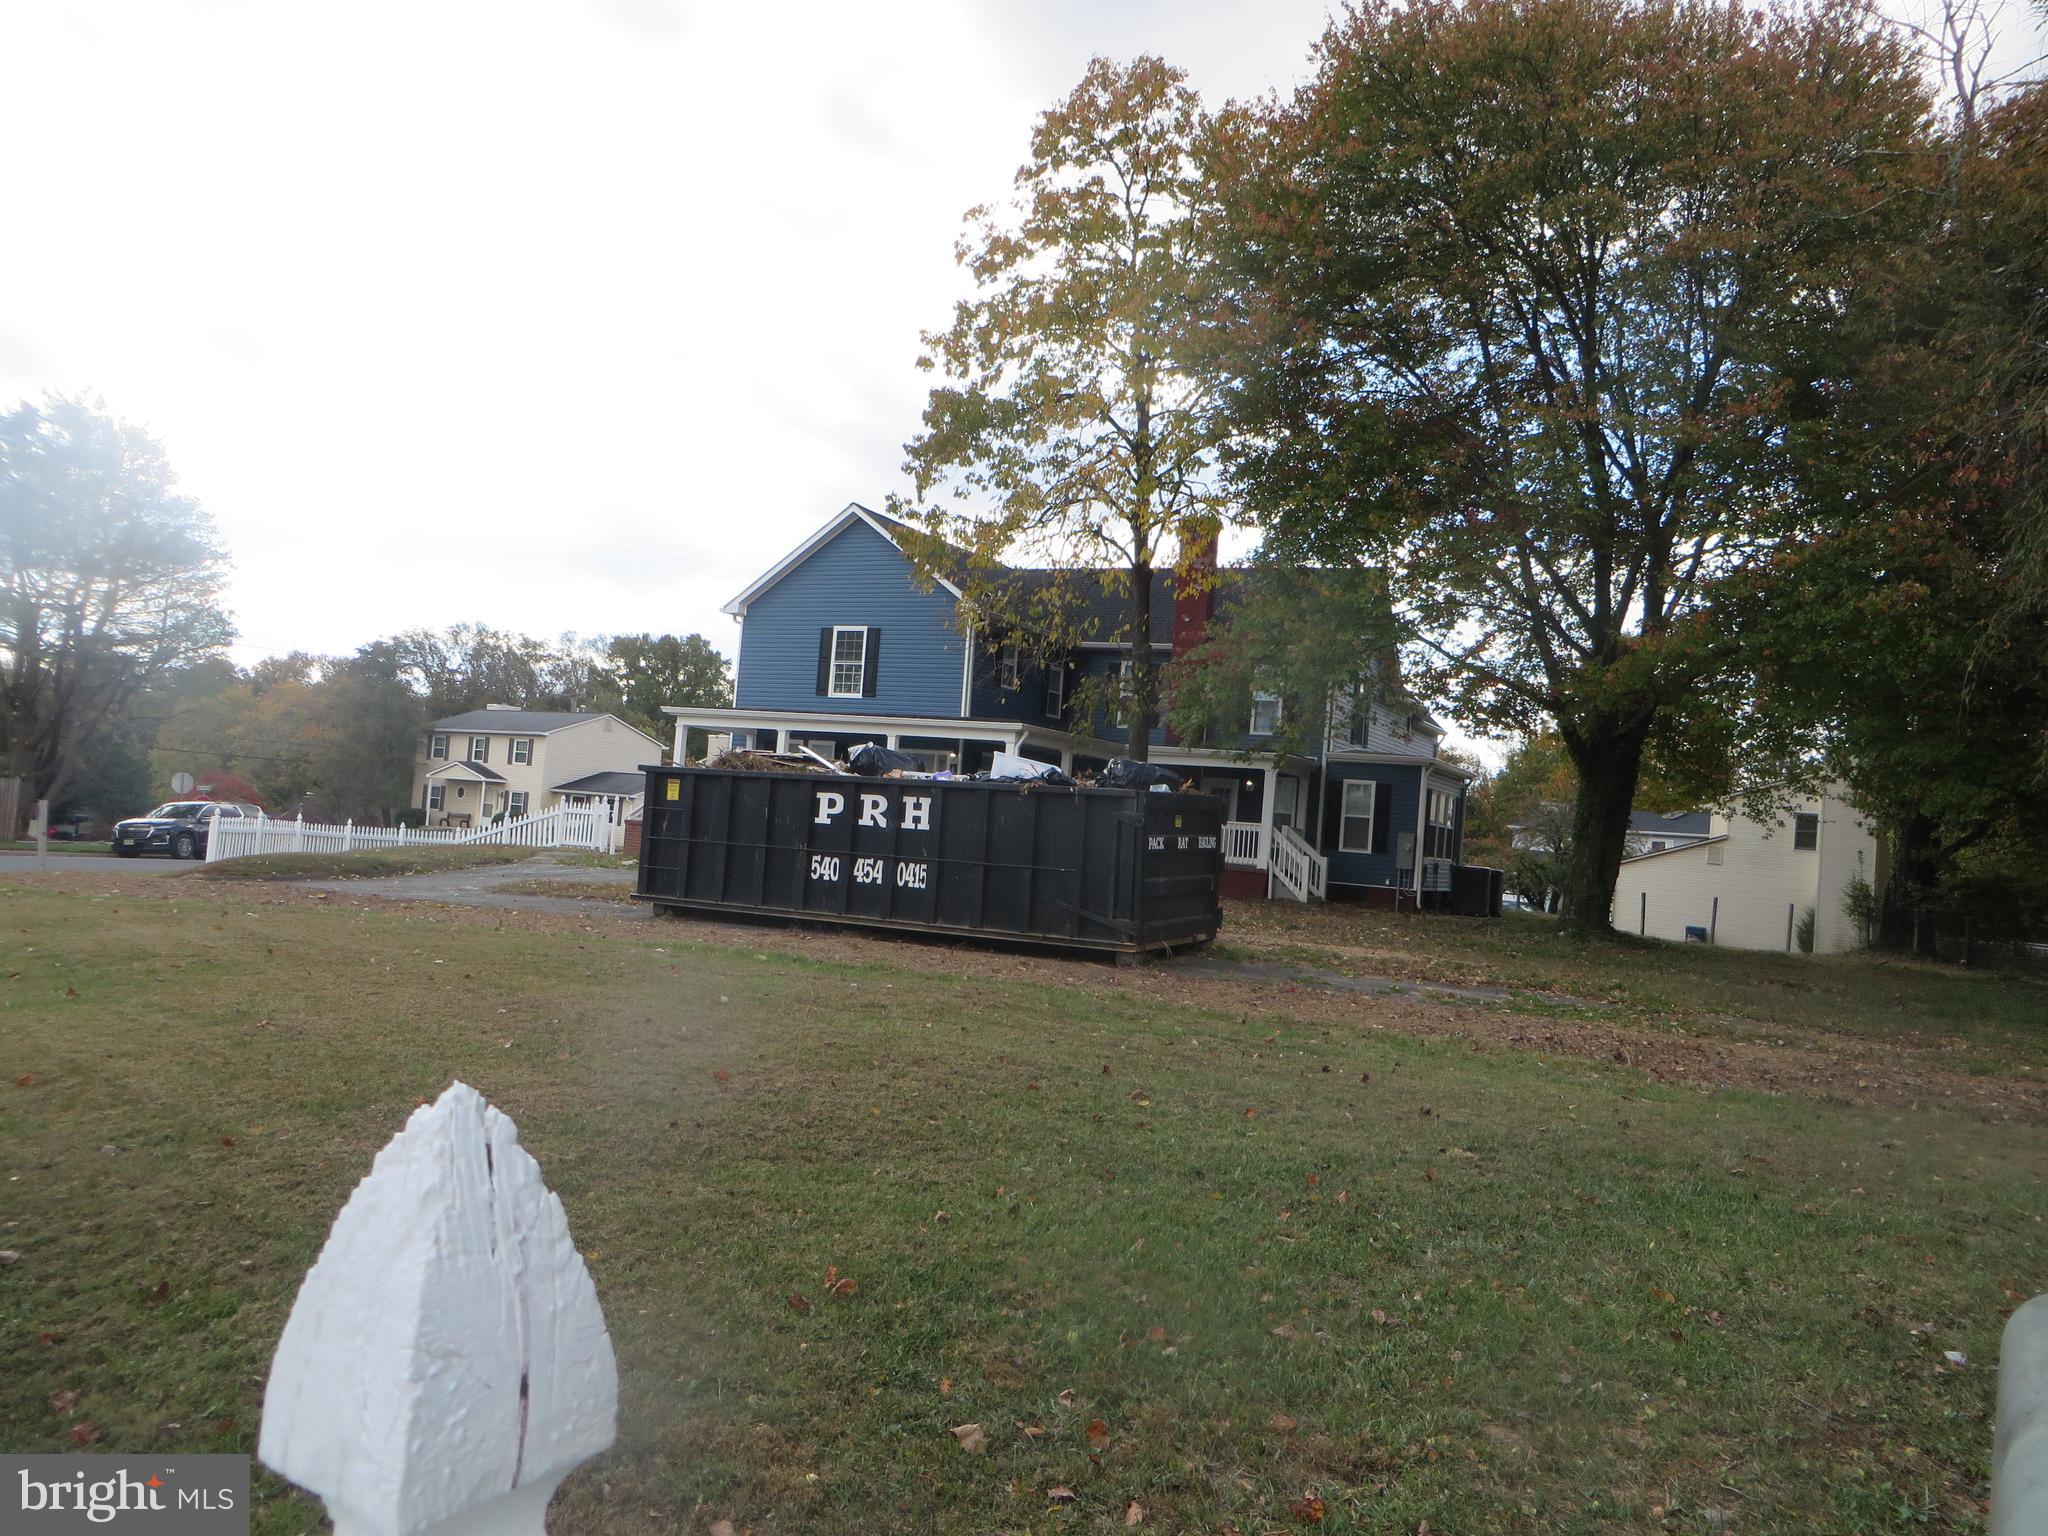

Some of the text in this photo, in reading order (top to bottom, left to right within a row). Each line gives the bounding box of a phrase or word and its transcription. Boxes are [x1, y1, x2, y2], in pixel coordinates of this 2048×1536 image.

[1148, 837, 1165, 850] PACK
[1177, 837, 1189, 849] RAT
[810, 855, 928, 889] 540 454 0415
